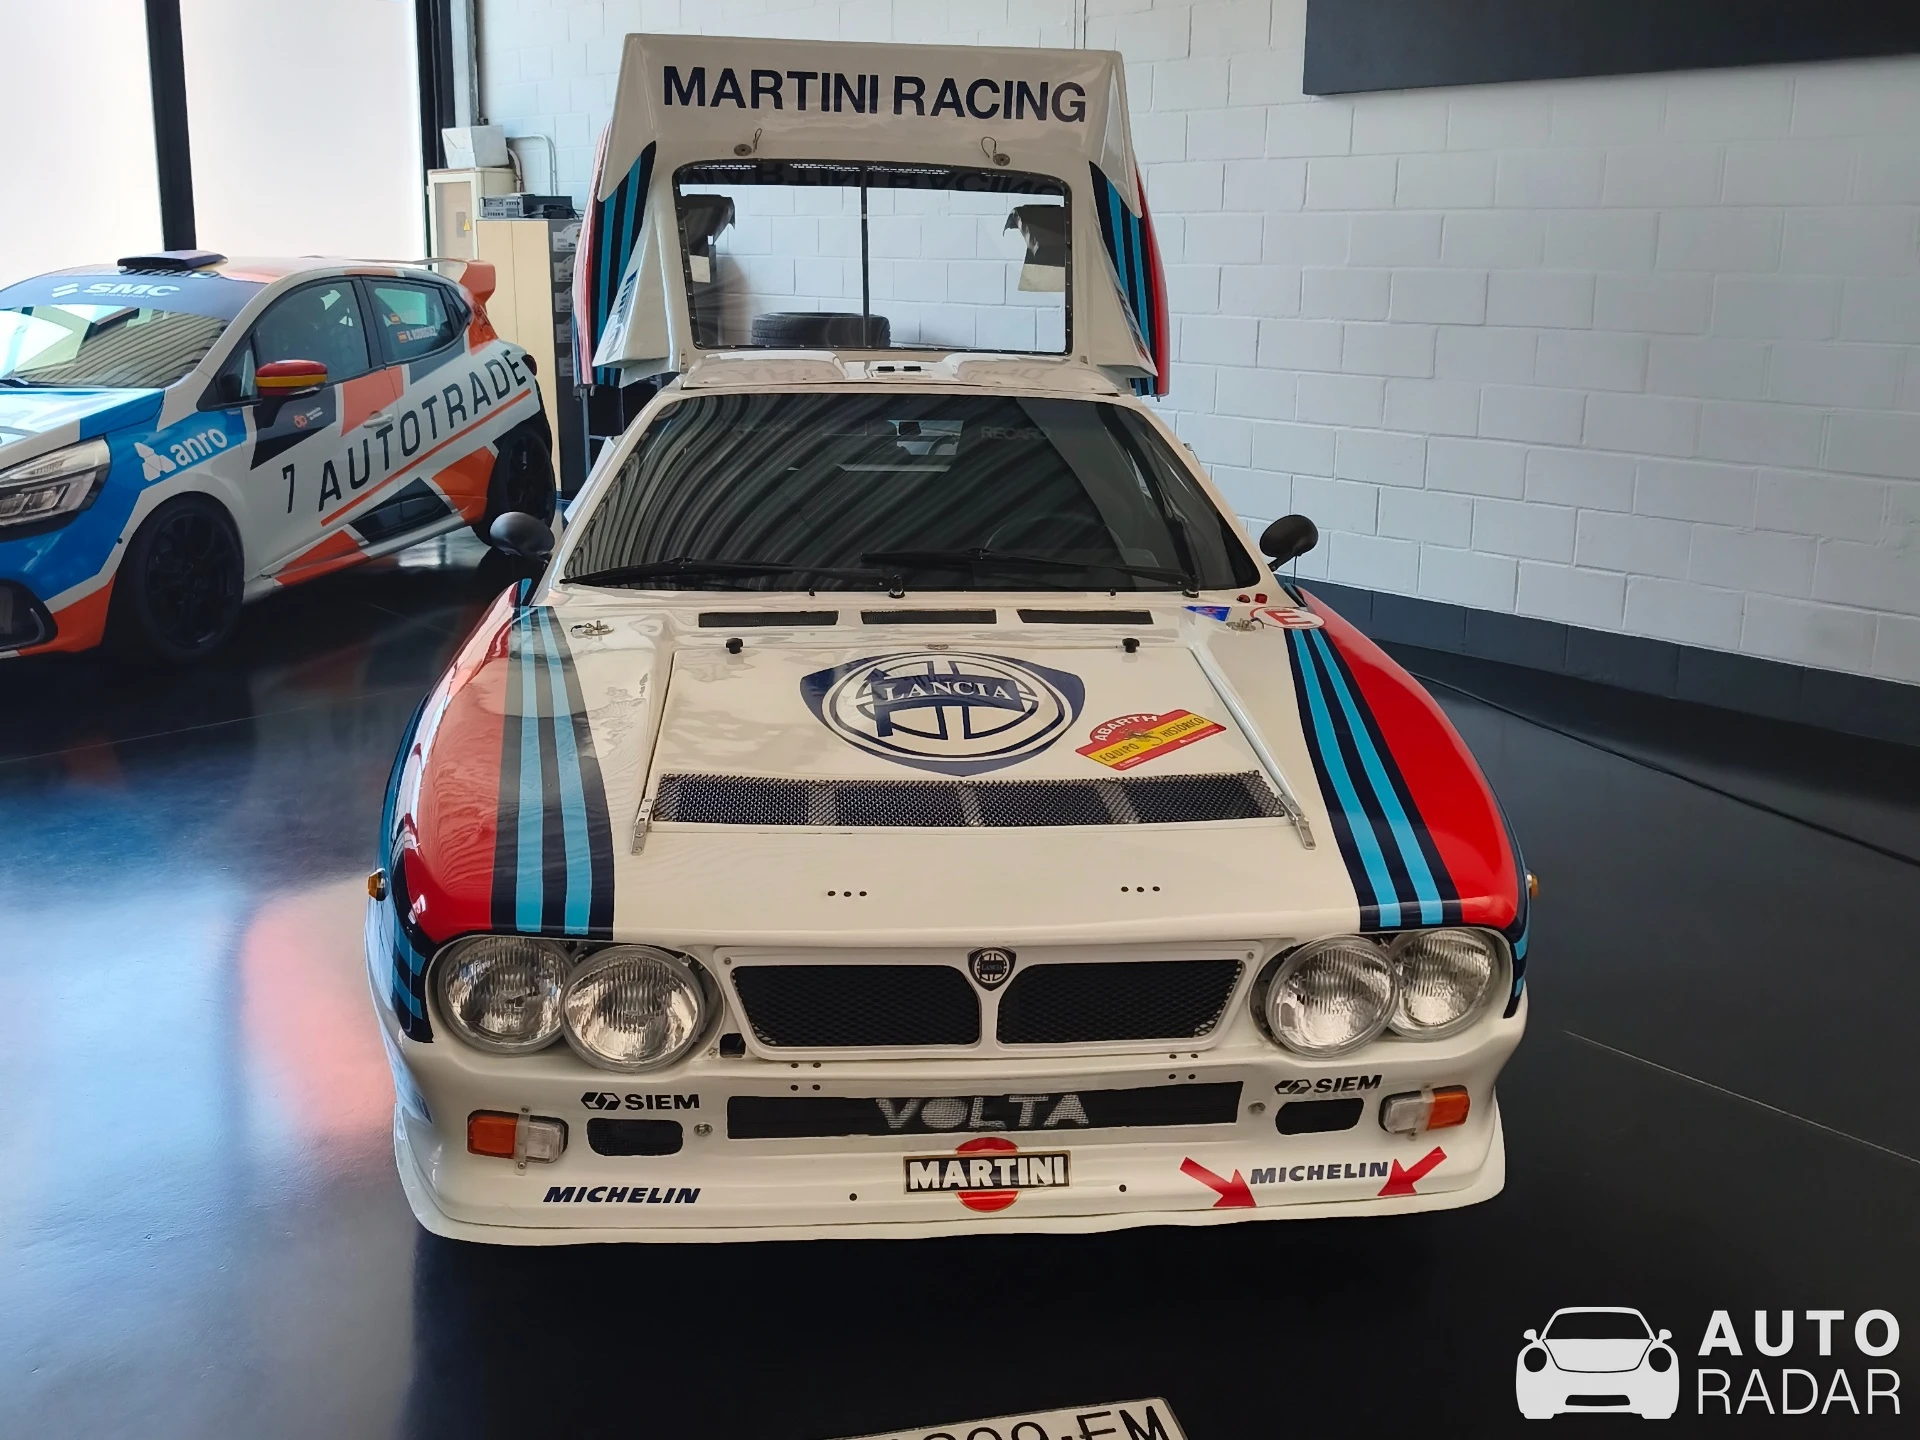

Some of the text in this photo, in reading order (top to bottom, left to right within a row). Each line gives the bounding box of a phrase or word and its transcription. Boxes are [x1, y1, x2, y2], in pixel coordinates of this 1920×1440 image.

[663, 65, 1086, 123] MARTINI RACING
[83, 282, 181, 297] SMC
[282, 349, 527, 514] 7 AUTOTRADE
[170, 428, 228, 466] anro
[884, 681, 1014, 702] LANCIA
[1094, 715, 1158, 742] ABARTH
[1099, 743, 1140, 762] EQUIPO
[1159, 716, 1205, 738] HISTÓRICO
[1313, 1074, 1383, 1094] SIEM
[624, 1094, 700, 1110] SIEM
[876, 1094, 1089, 1129] VOLTA
[910, 1156, 1065, 1190] MARTINI
[1250, 1161, 1389, 1185] MICHELIN
[543, 1186, 702, 1204] MICHELIN
